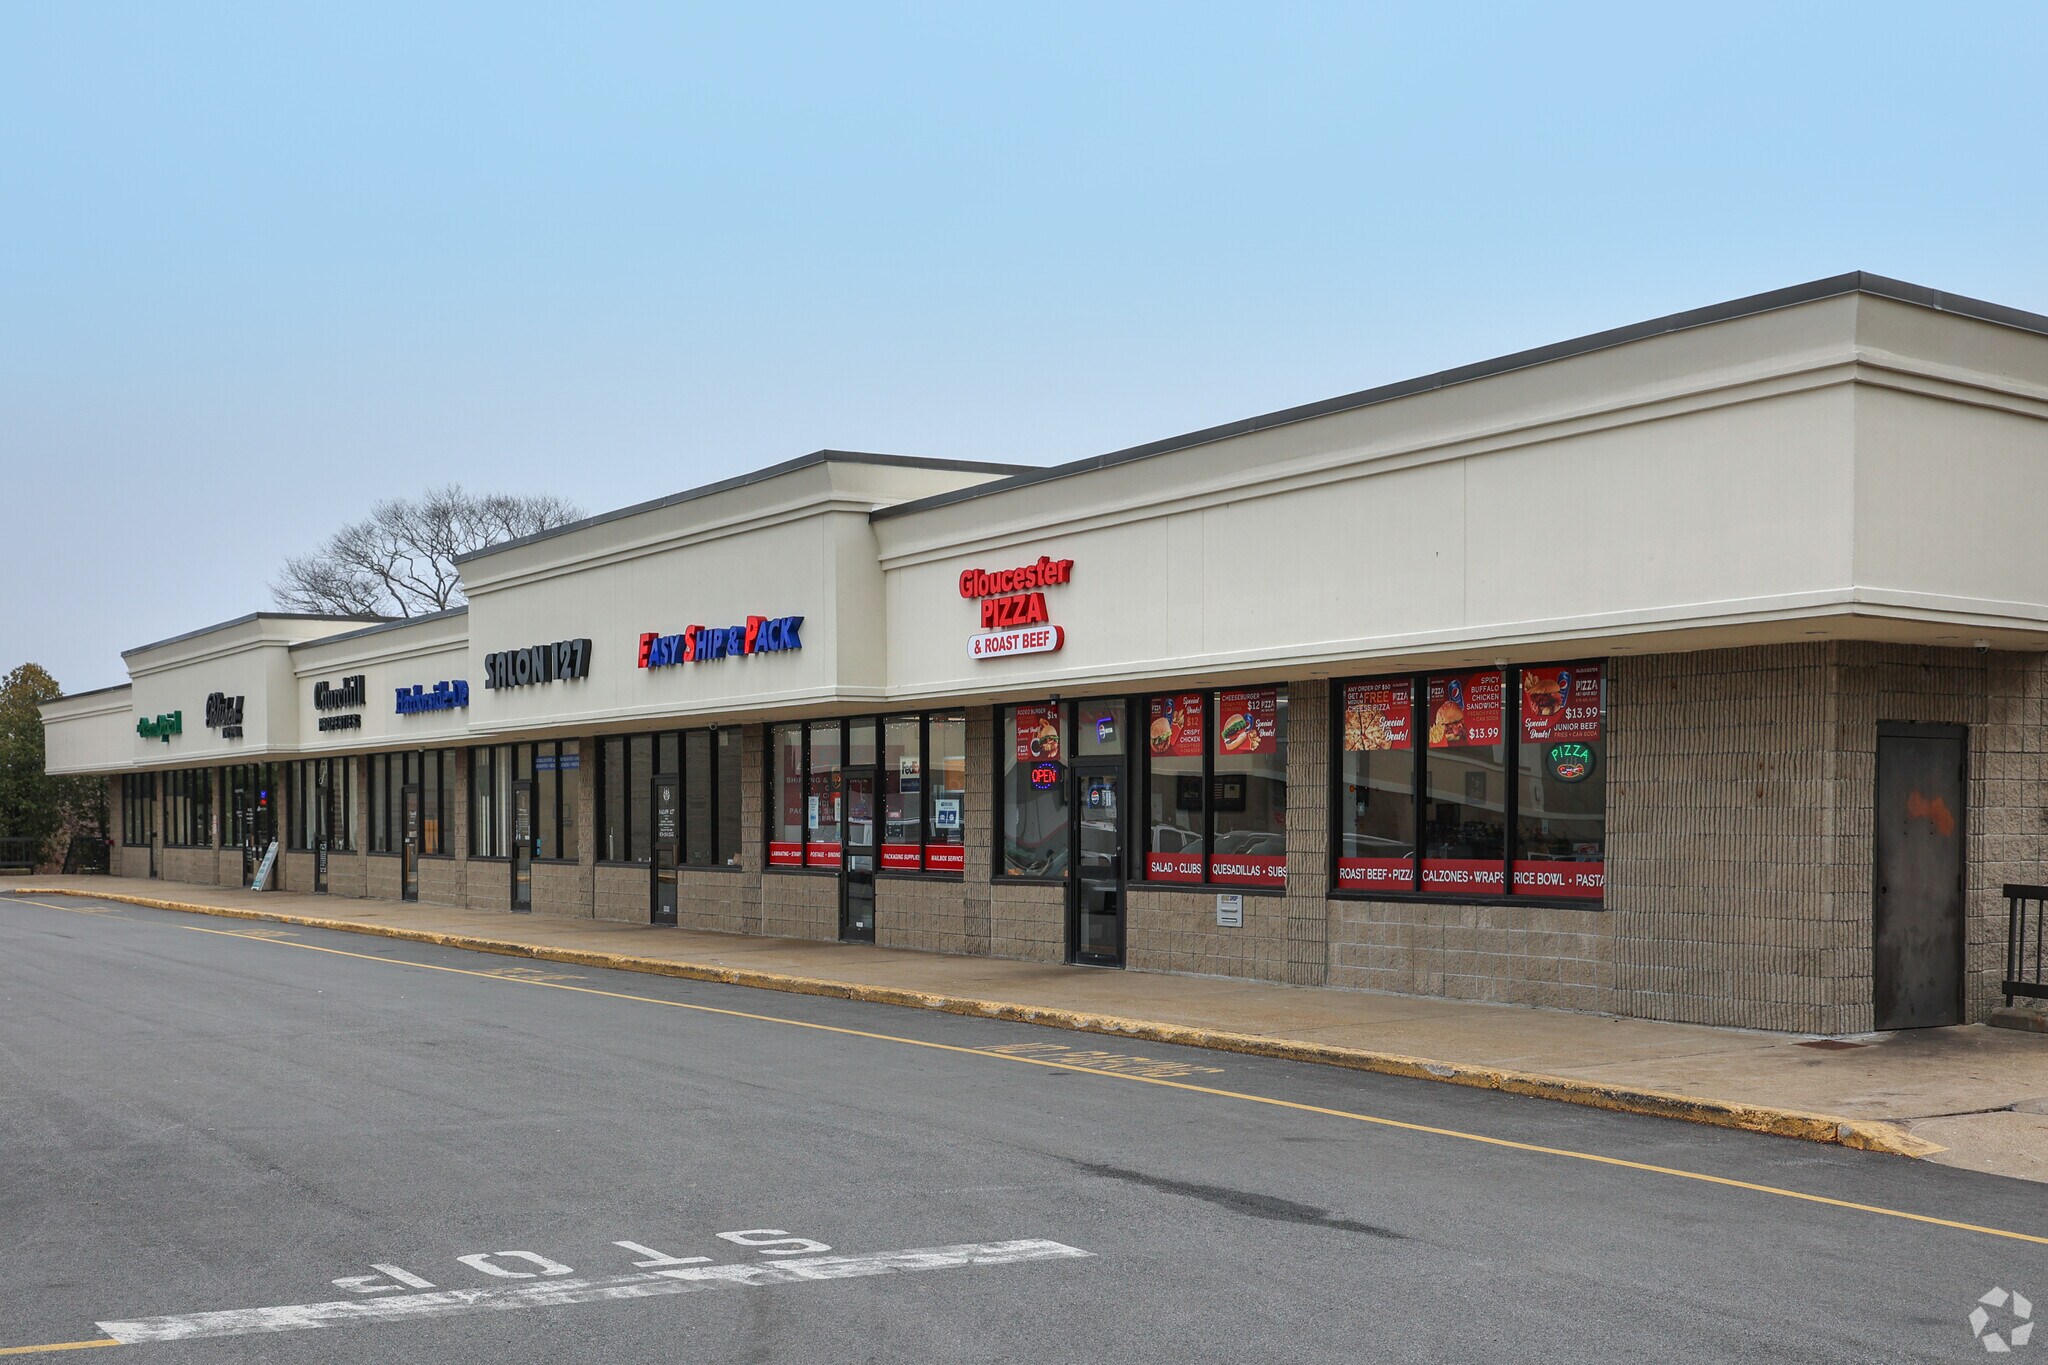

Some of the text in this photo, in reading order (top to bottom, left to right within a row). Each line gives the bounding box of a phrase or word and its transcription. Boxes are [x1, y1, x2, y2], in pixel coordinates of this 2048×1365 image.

[959, 556, 1074, 598] Gloucester
[981, 592, 1048, 628] PIZZA
[727, 626, 746, 656] &
[974, 631, 1050, 654] & ROAST BEEF
[485, 638, 592, 689] SALON 127
[1471, 685, 1499, 693] BUFFALO
[1576, 680, 1598, 691] PIZZA
[314, 675, 366, 710] Churchill
[1222, 693, 1260, 701] CHEESEBURGER
[1364, 691, 1391, 704] FREE
[1392, 692, 1408, 701] PIZZA
[1472, 694, 1499, 702] CHICKEN
[1247, 701, 1260, 711] $12
[1466, 702, 1499, 710] SANDWICH
[1565, 707, 1598, 720] $13.99
[319, 714, 362, 731] PROPERTIES
[1187, 717, 1198, 727] $12
[1379, 717, 1405, 730] Special
[1525, 718, 1548, 731] Special
[1554, 722, 1598, 731] JUNIOR BEEF
[1469, 727, 1499, 739] $13.99
[1551, 745, 1588, 763] PIZZA
[1031, 769, 1056, 783] OPEN
[1151, 863, 1202, 875] SALAD CLUBS
[1212, 863, 1261, 877] QUESADILLAS
[1339, 867, 1365, 880] ROAST
[1366, 868, 1388, 880] BEEF
[1422, 869, 1469, 883] CALZONES
[1513, 871, 1535, 885] RICE
[1537, 872, 1565, 886] BOWL
[331, 1229, 832, 1293] STOP
